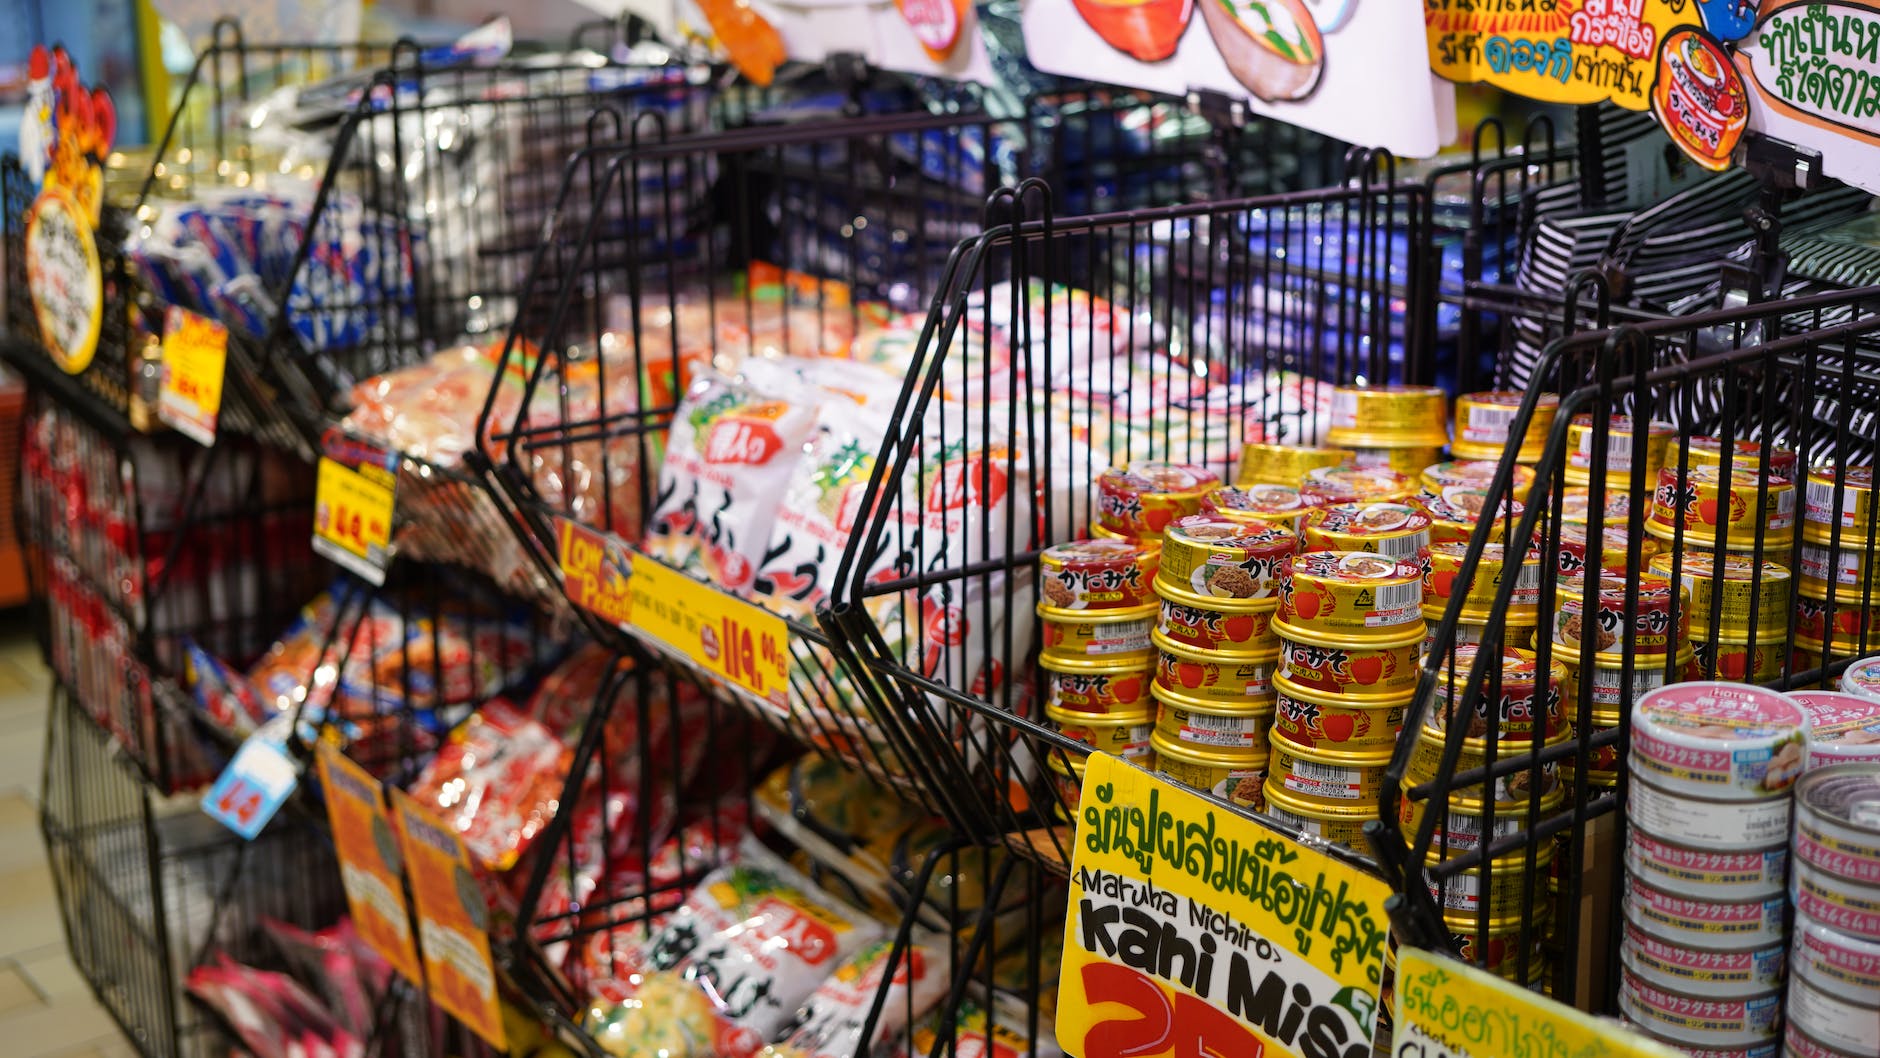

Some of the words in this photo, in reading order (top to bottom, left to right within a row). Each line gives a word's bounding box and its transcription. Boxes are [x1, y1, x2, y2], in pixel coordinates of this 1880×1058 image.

[1484, 36, 1573, 85] ดองกิ
[1057, 564, 1141, 591] かにみそ
